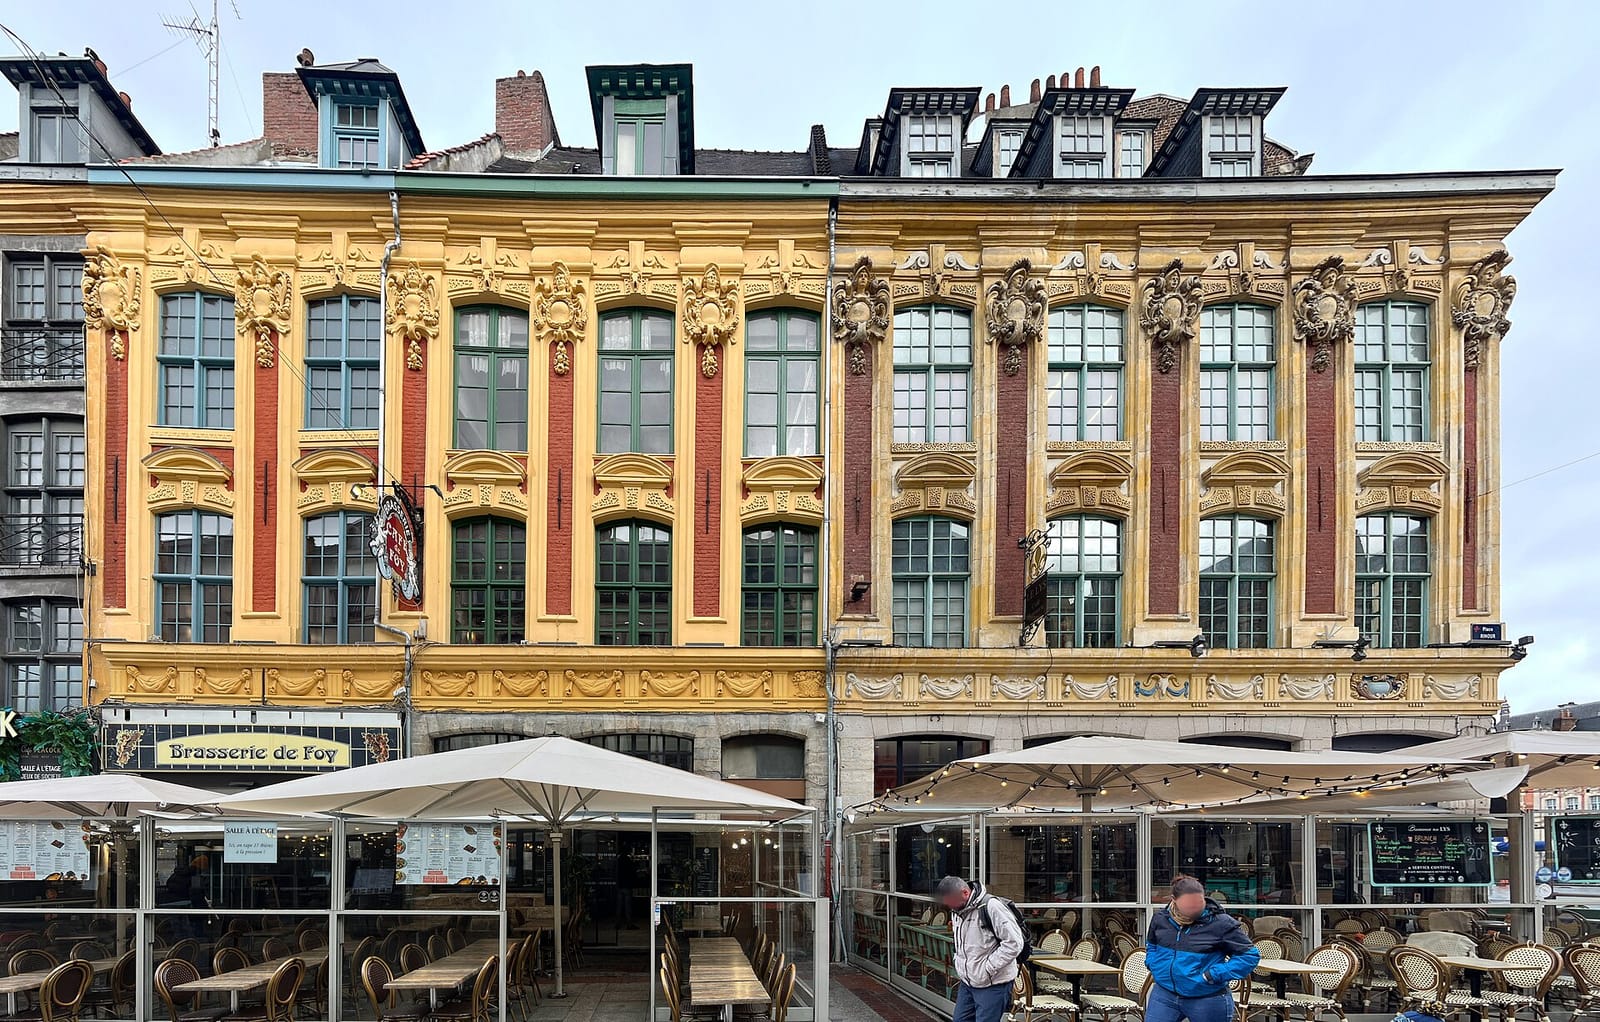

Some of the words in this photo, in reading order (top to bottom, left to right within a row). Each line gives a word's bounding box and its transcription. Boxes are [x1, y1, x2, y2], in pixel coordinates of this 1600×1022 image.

[384, 500, 411, 536] BRASSERIE
[389, 548, 405, 573] FOY
[169, 744, 267, 760] Brasserie
[273, 745, 298, 760] de
[303, 746, 338, 763] Foy
[36, 763, 41, 772] À
[246, 825, 251, 834] À
